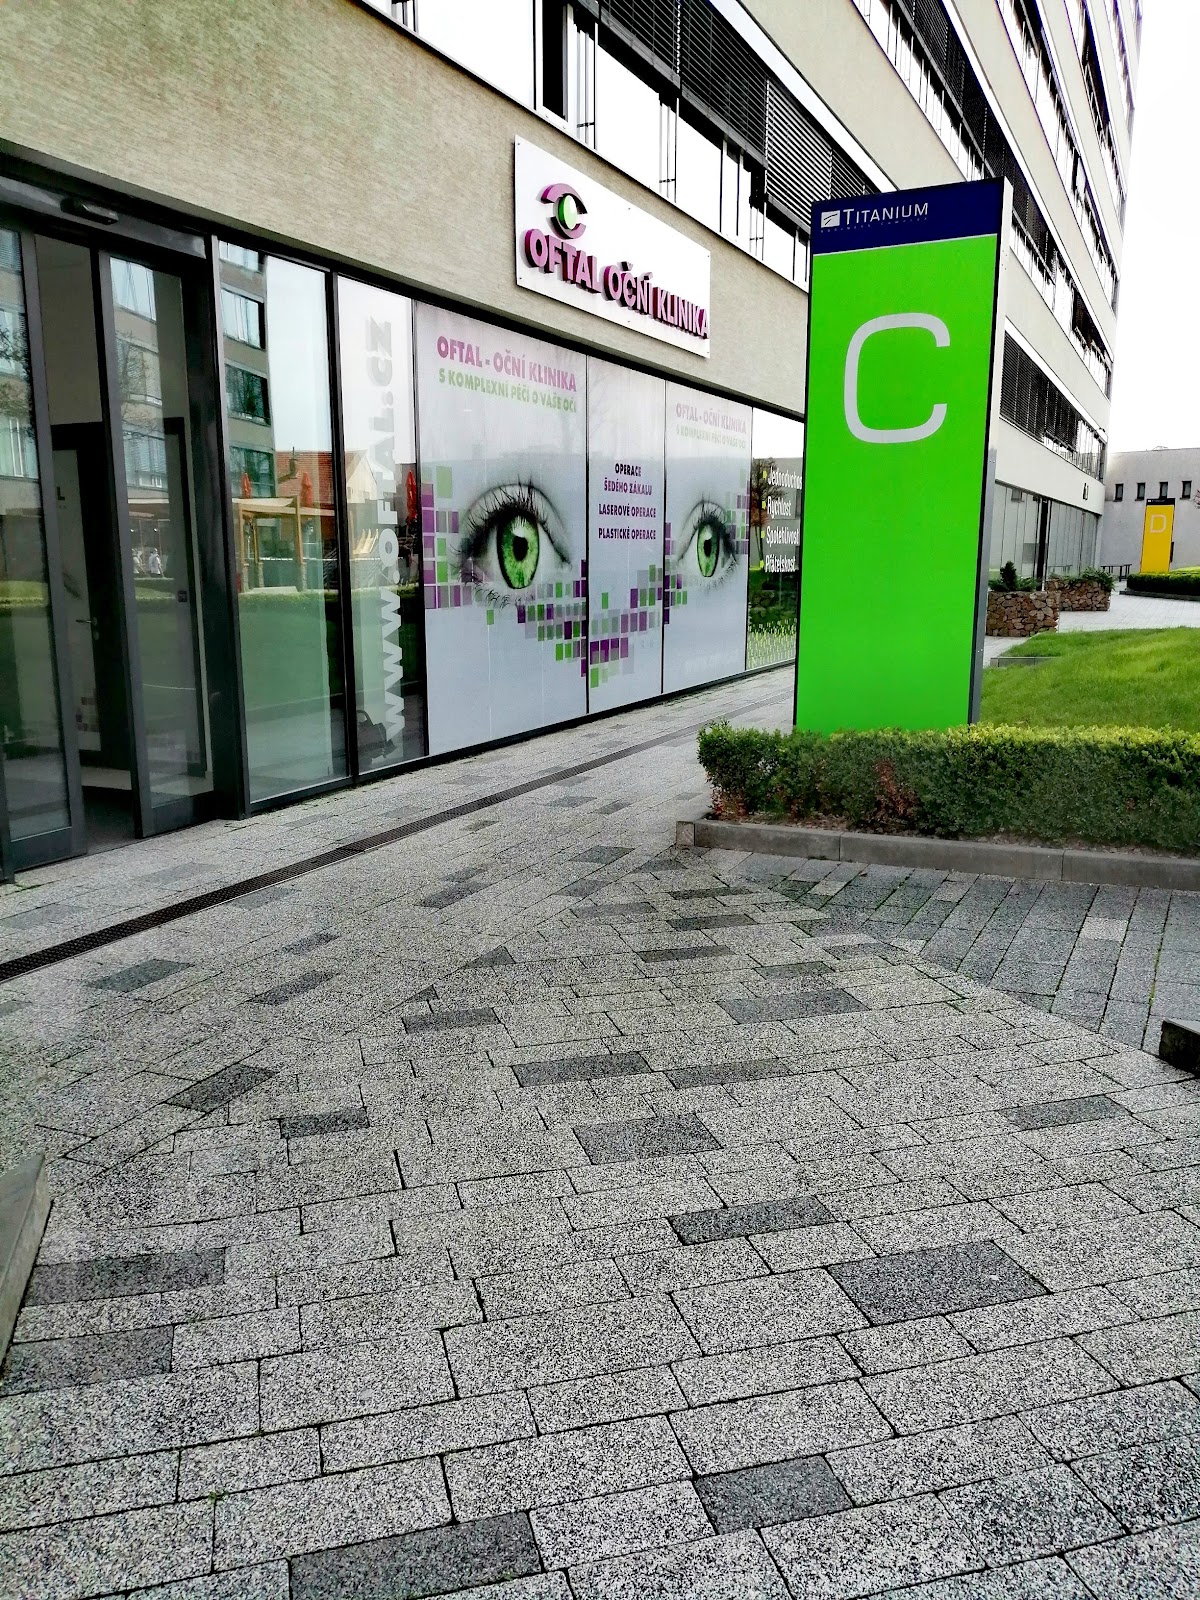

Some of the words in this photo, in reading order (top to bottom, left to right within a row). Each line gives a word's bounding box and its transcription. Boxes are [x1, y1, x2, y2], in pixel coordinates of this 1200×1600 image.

[843, 203, 928, 225] TITANIUM
[525, 229, 601, 293] OFTAL
[604, 261, 653, 315] OČNÍ
[653, 287, 709, 339] KLINIKA
[437, 335, 482, 368] OFTAL
[493, 349, 525, 379] OČNÍ
[529, 361, 576, 392] KLINIKA
[439, 368, 445, 383] S
[448, 370, 508, 398] KOMPLEXNÍ
[532, 393, 538, 404] O
[844, 312, 951, 444] C
[676, 403, 698, 422] OFTAL
[615, 463, 641, 477] OPERACE
[604, 477, 628, 493] ŠEDÉHO
[629, 481, 652, 495] ZÁKALU
[598, 503, 630, 516] LASEROVÉ
[631, 507, 656, 518] OPERACE
[767, 496, 792, 519] Rychlost
[598, 526, 630, 539] PLASTICKÉ
[631, 529, 656, 540] OPERACE
[1150, 514, 1166, 533] D
